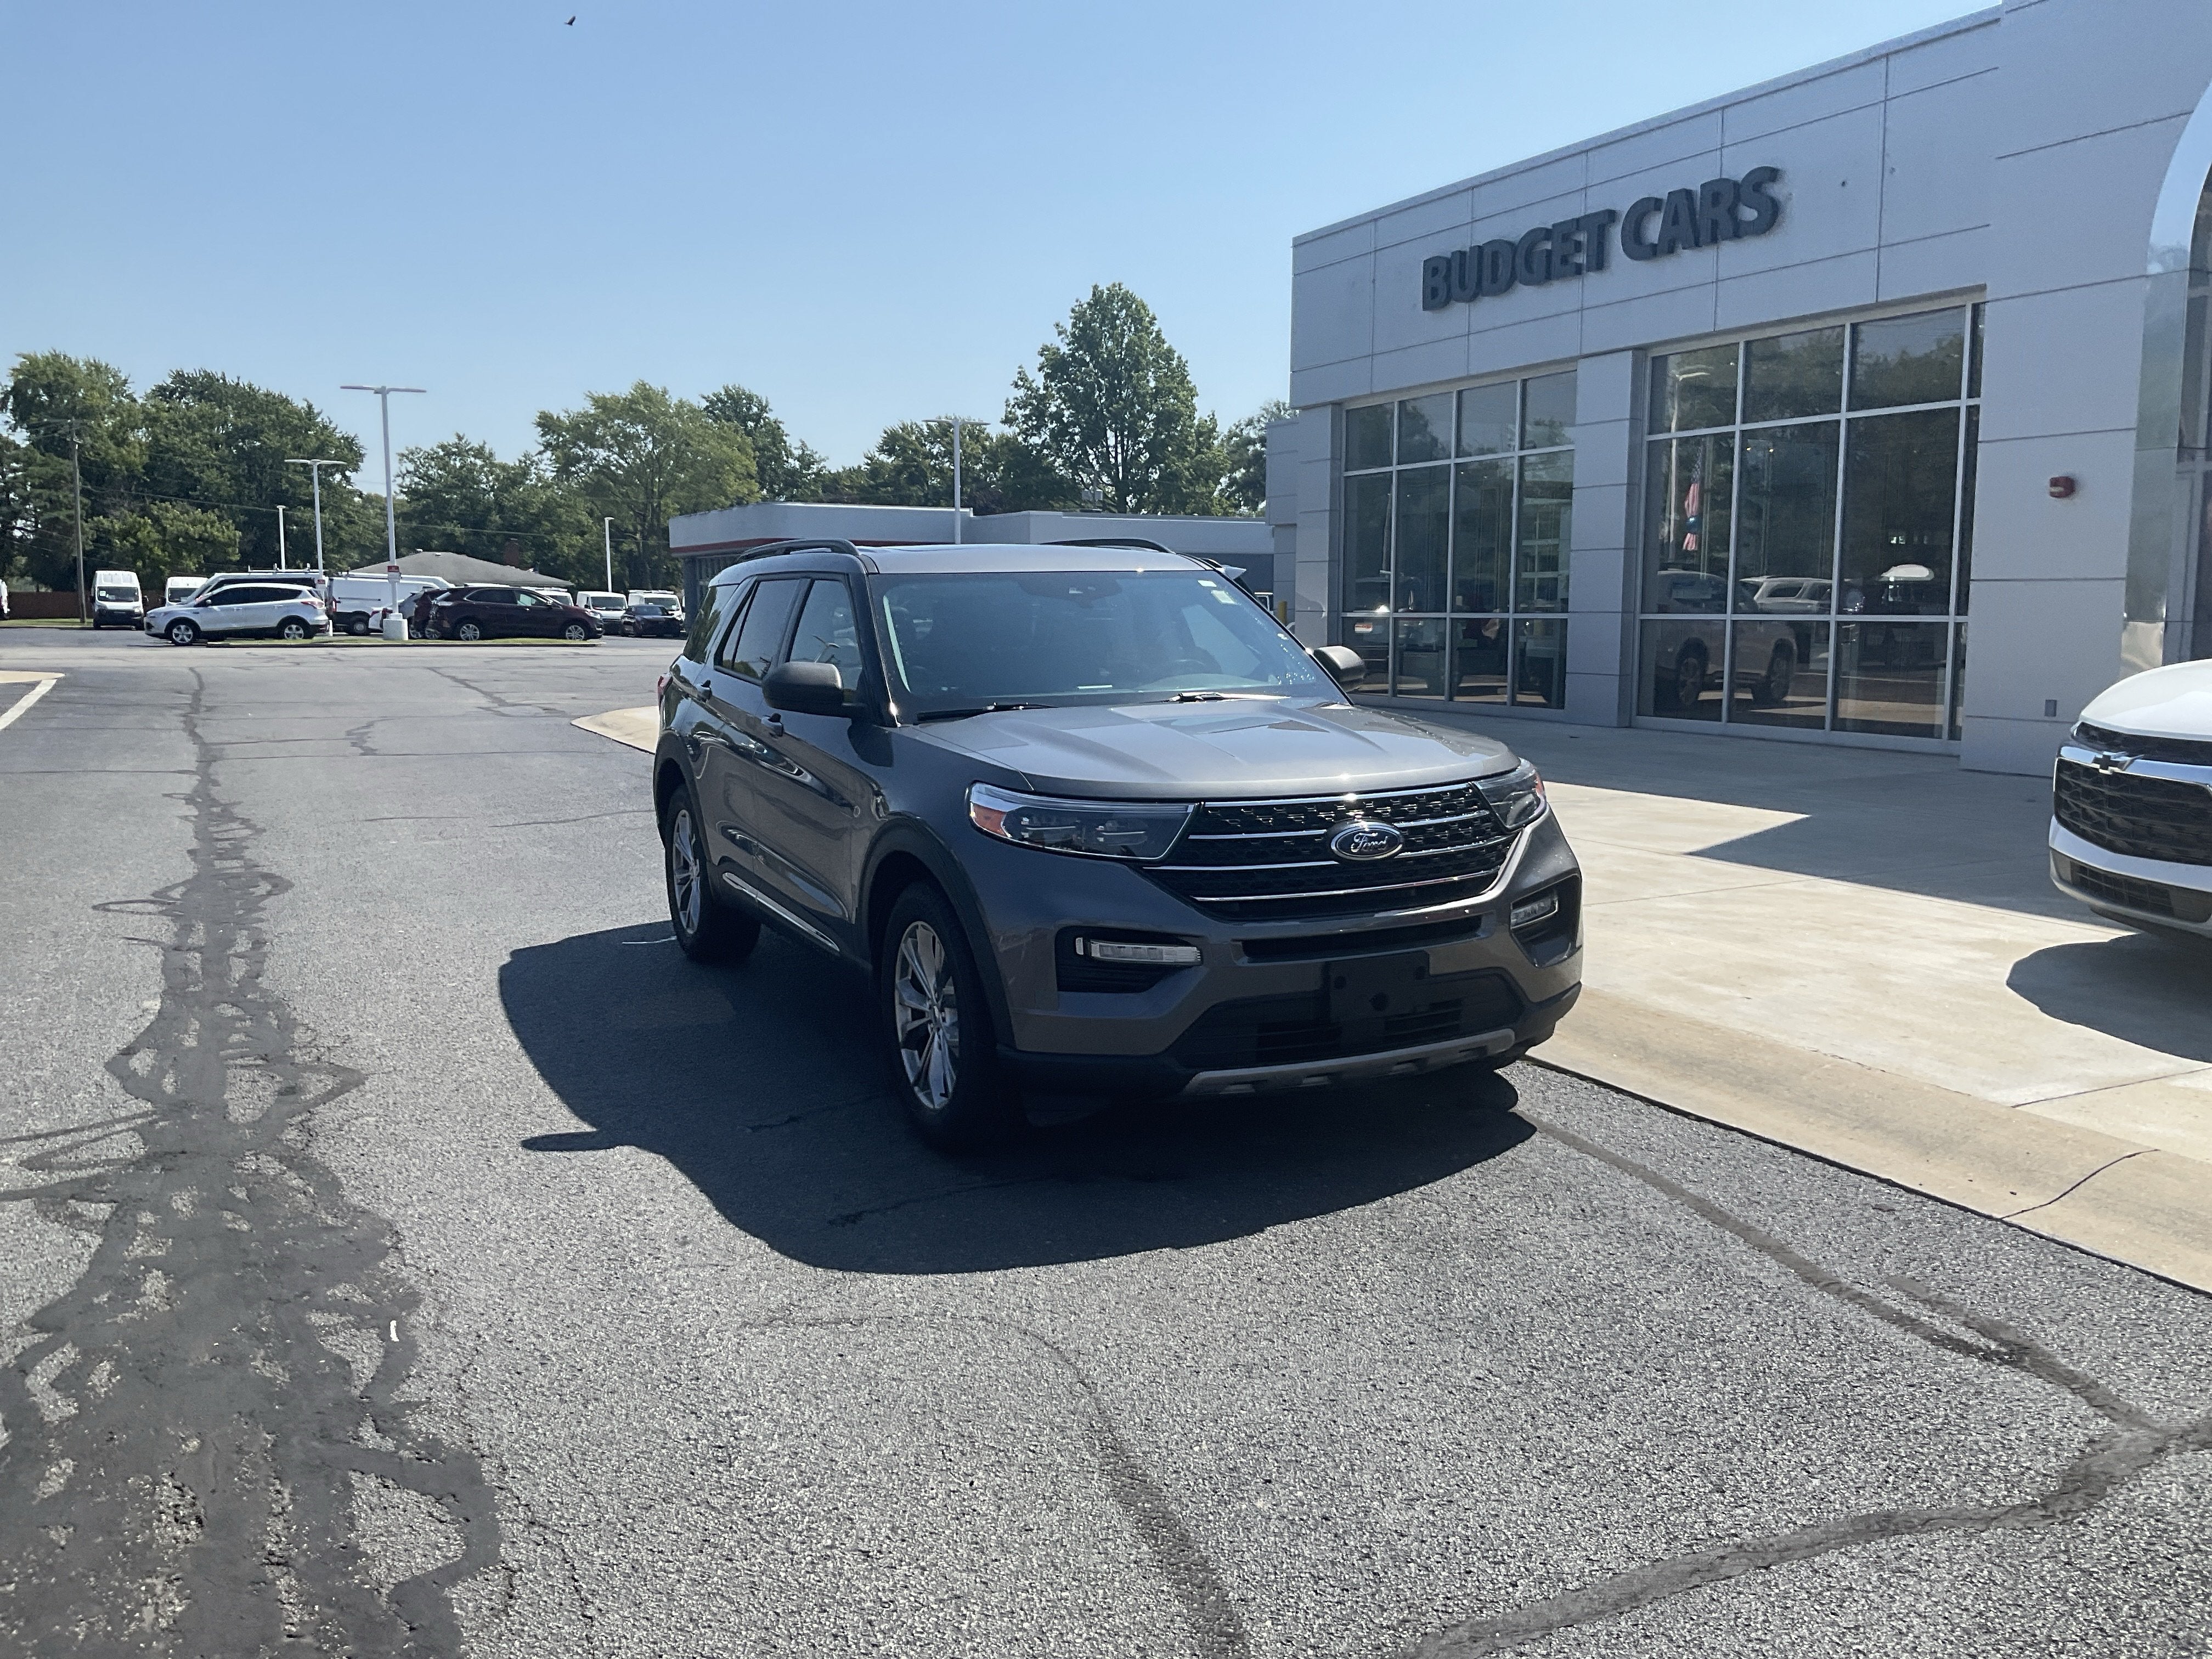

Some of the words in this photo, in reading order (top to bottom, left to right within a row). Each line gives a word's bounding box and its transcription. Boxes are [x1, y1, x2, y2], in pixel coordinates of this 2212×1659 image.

[1423, 209, 1617, 311] BUDGET
[1621, 166, 1784, 261] CARS
[1351, 832, 1388, 852] Ford
